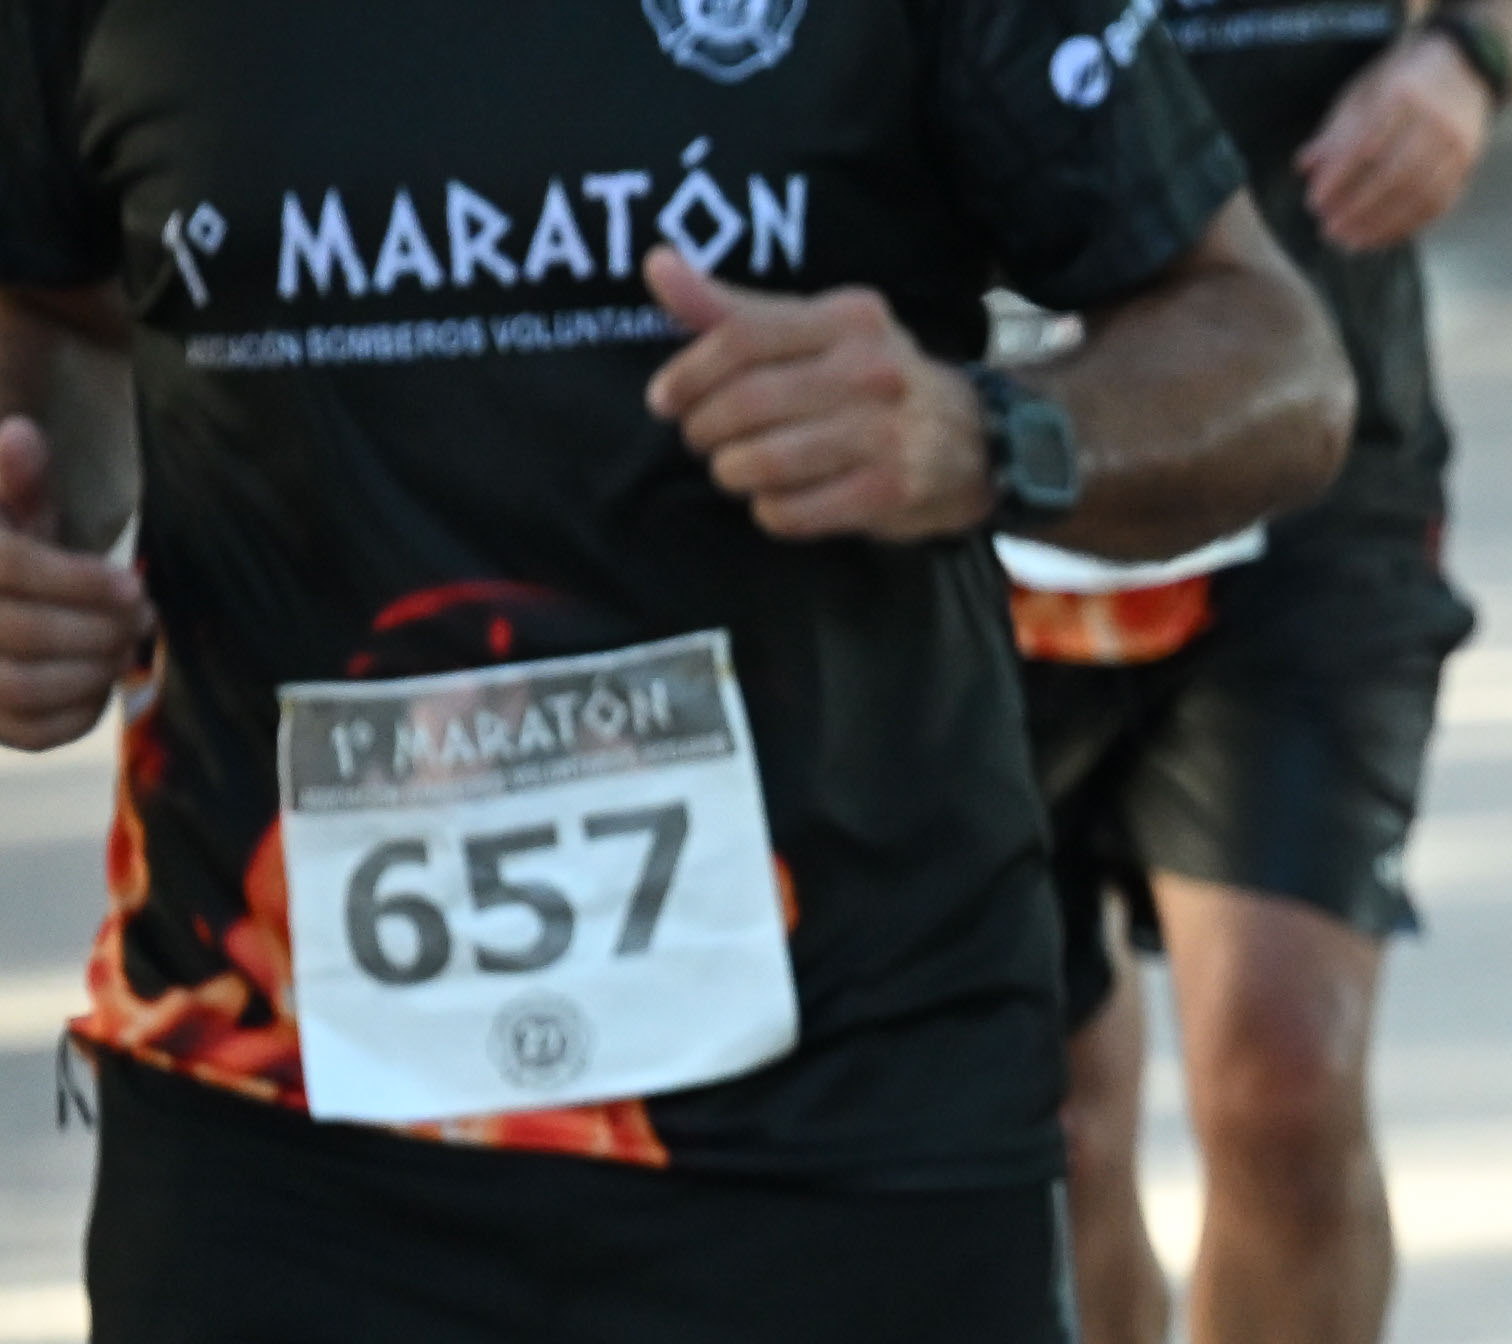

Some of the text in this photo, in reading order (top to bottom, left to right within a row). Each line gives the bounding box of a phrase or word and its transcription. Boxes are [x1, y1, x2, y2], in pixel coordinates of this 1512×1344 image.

[276, 134, 809, 304] MARATÓN
[392, 672, 673, 776] MARATÓN
[345, 798, 690, 988] 657
